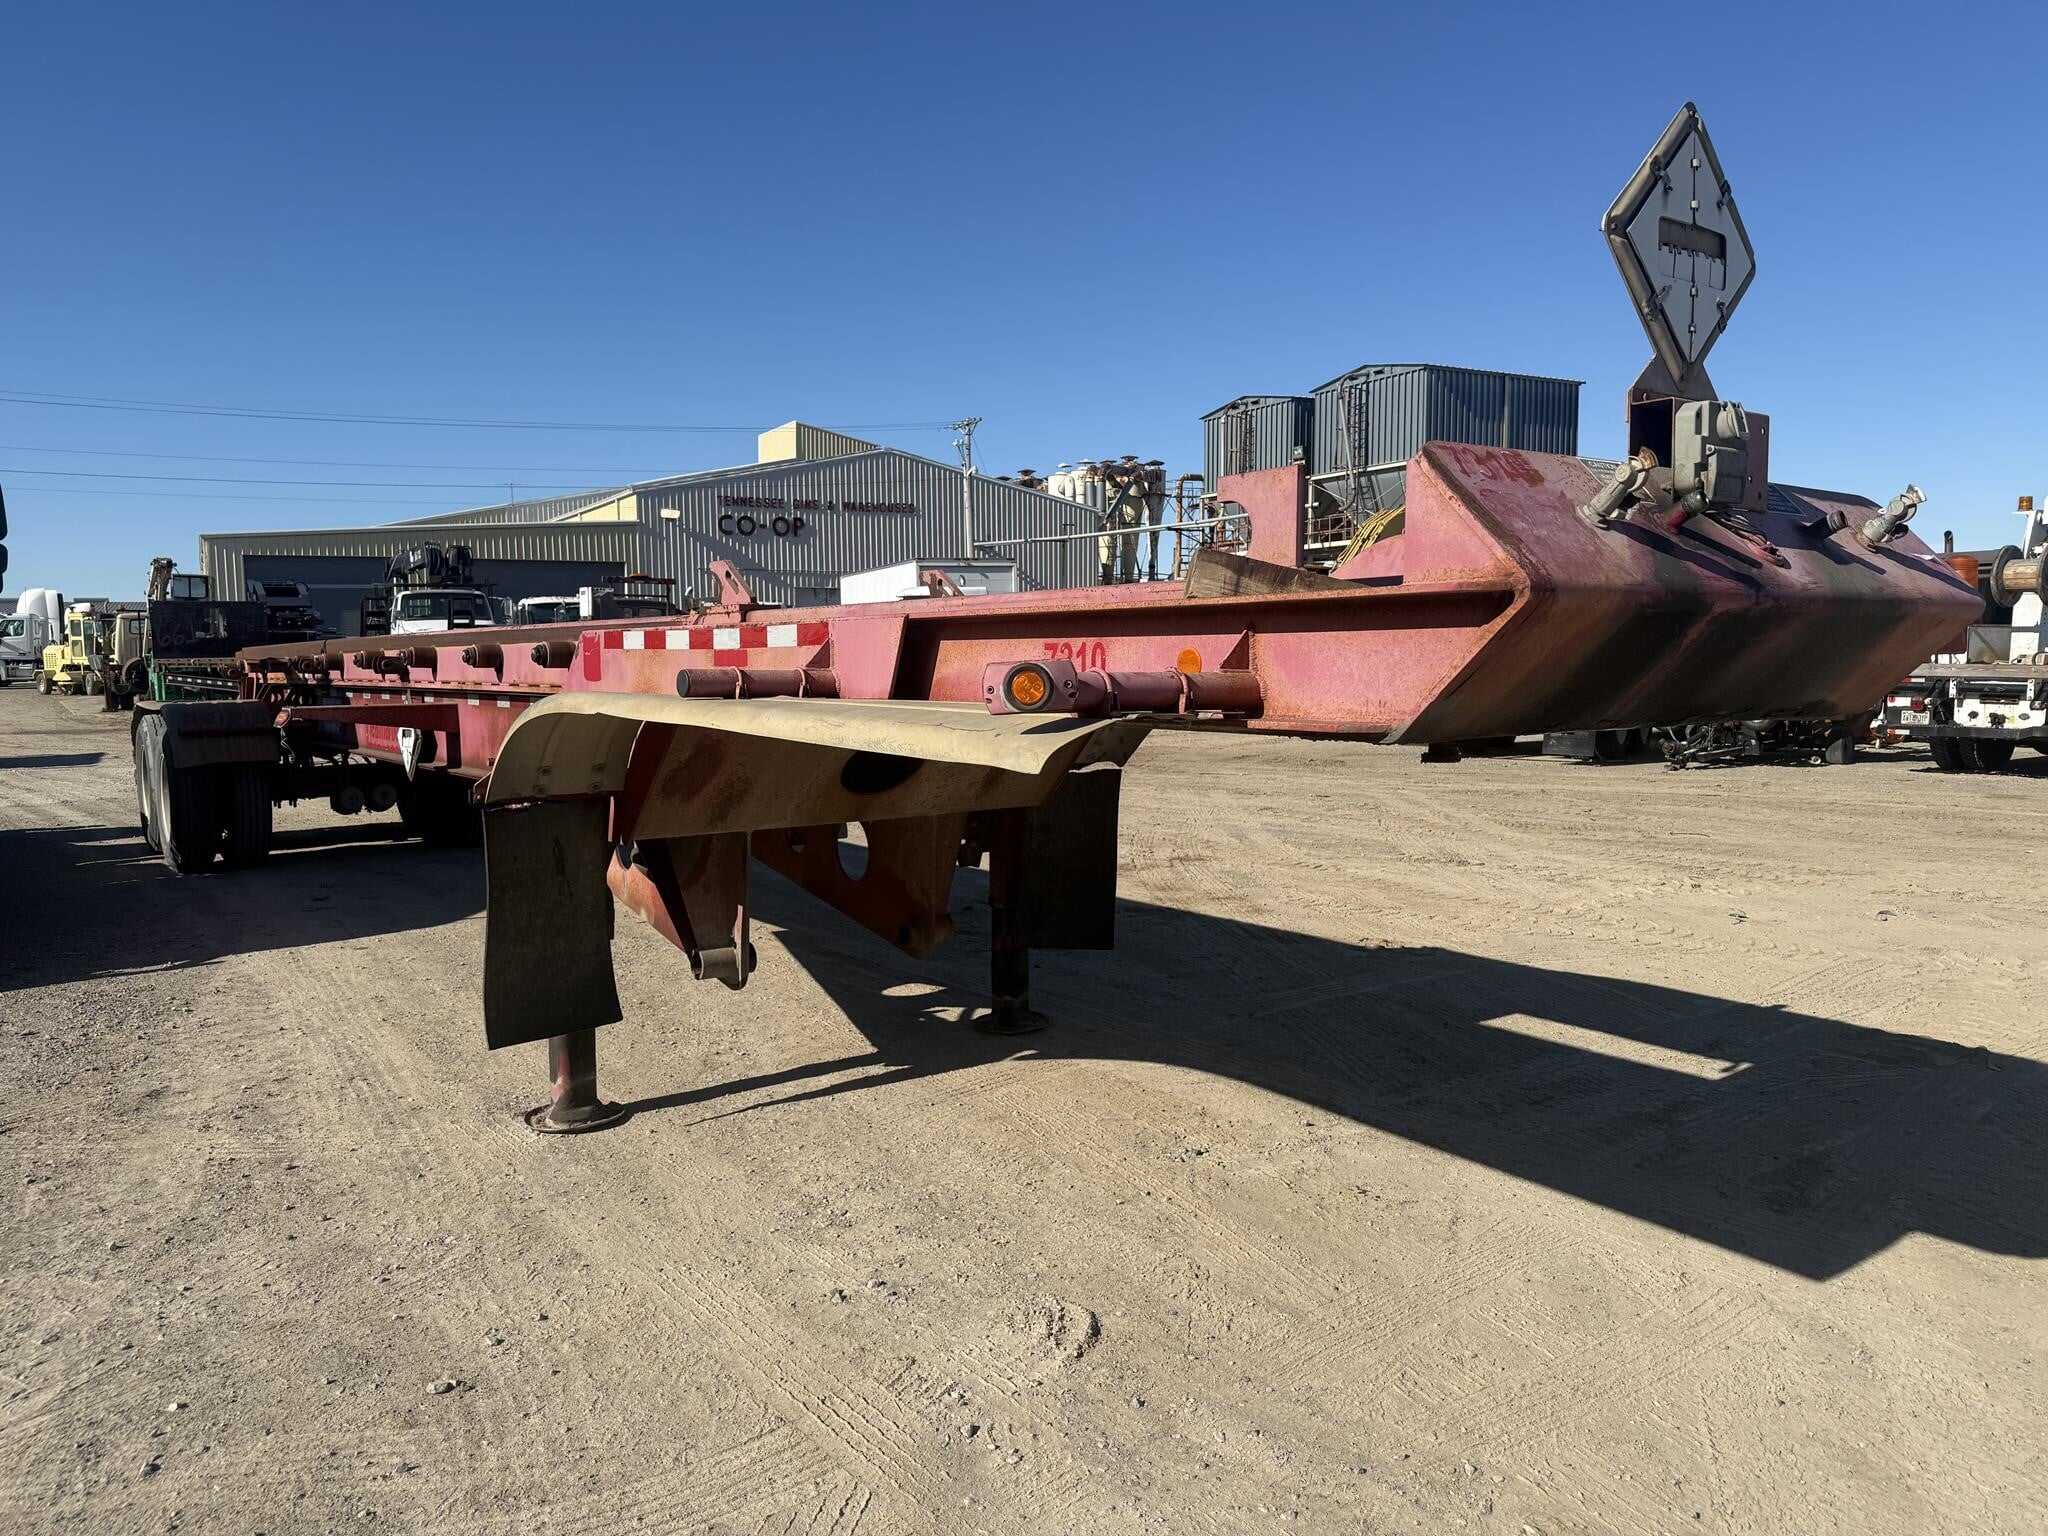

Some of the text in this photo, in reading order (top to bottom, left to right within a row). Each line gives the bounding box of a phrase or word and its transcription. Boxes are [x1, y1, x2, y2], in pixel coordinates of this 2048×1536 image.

[718, 496, 784, 509] TENNESSEE
[843, 502, 915, 514] WAREHOUSES
[718, 514, 805, 537] CO-OP
